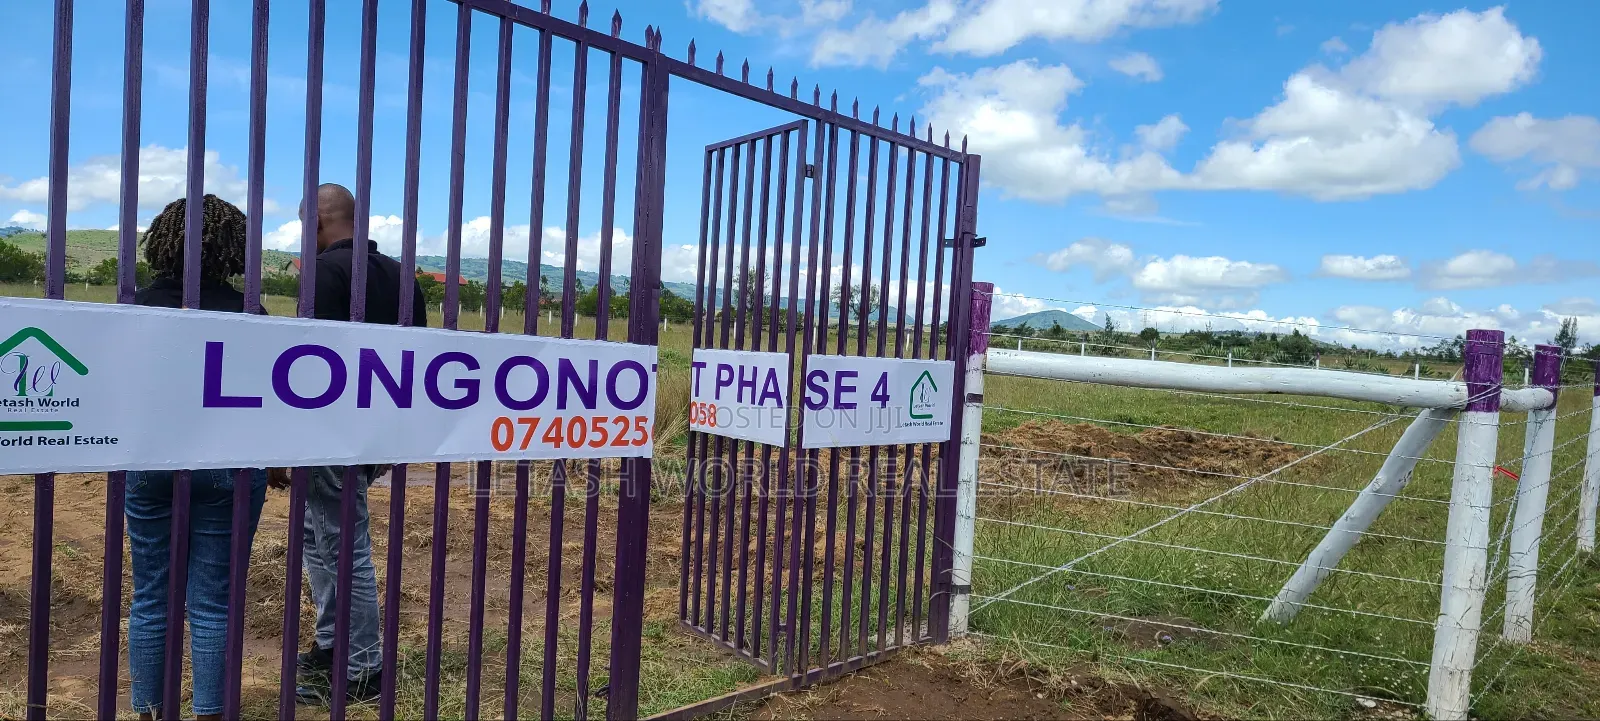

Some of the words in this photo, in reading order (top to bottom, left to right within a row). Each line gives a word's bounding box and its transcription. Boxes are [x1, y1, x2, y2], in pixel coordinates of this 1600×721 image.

[203, 341, 656, 411] LONGONO
[870, 371, 890, 409] 4
[0, 398, 34, 407] tash
[38, 398, 80, 407] World
[0, 436, 33, 446] orld
[37, 436, 70, 446] Real
[74, 435, 119, 445] Estate
[490, 415, 654, 452] 0740525
